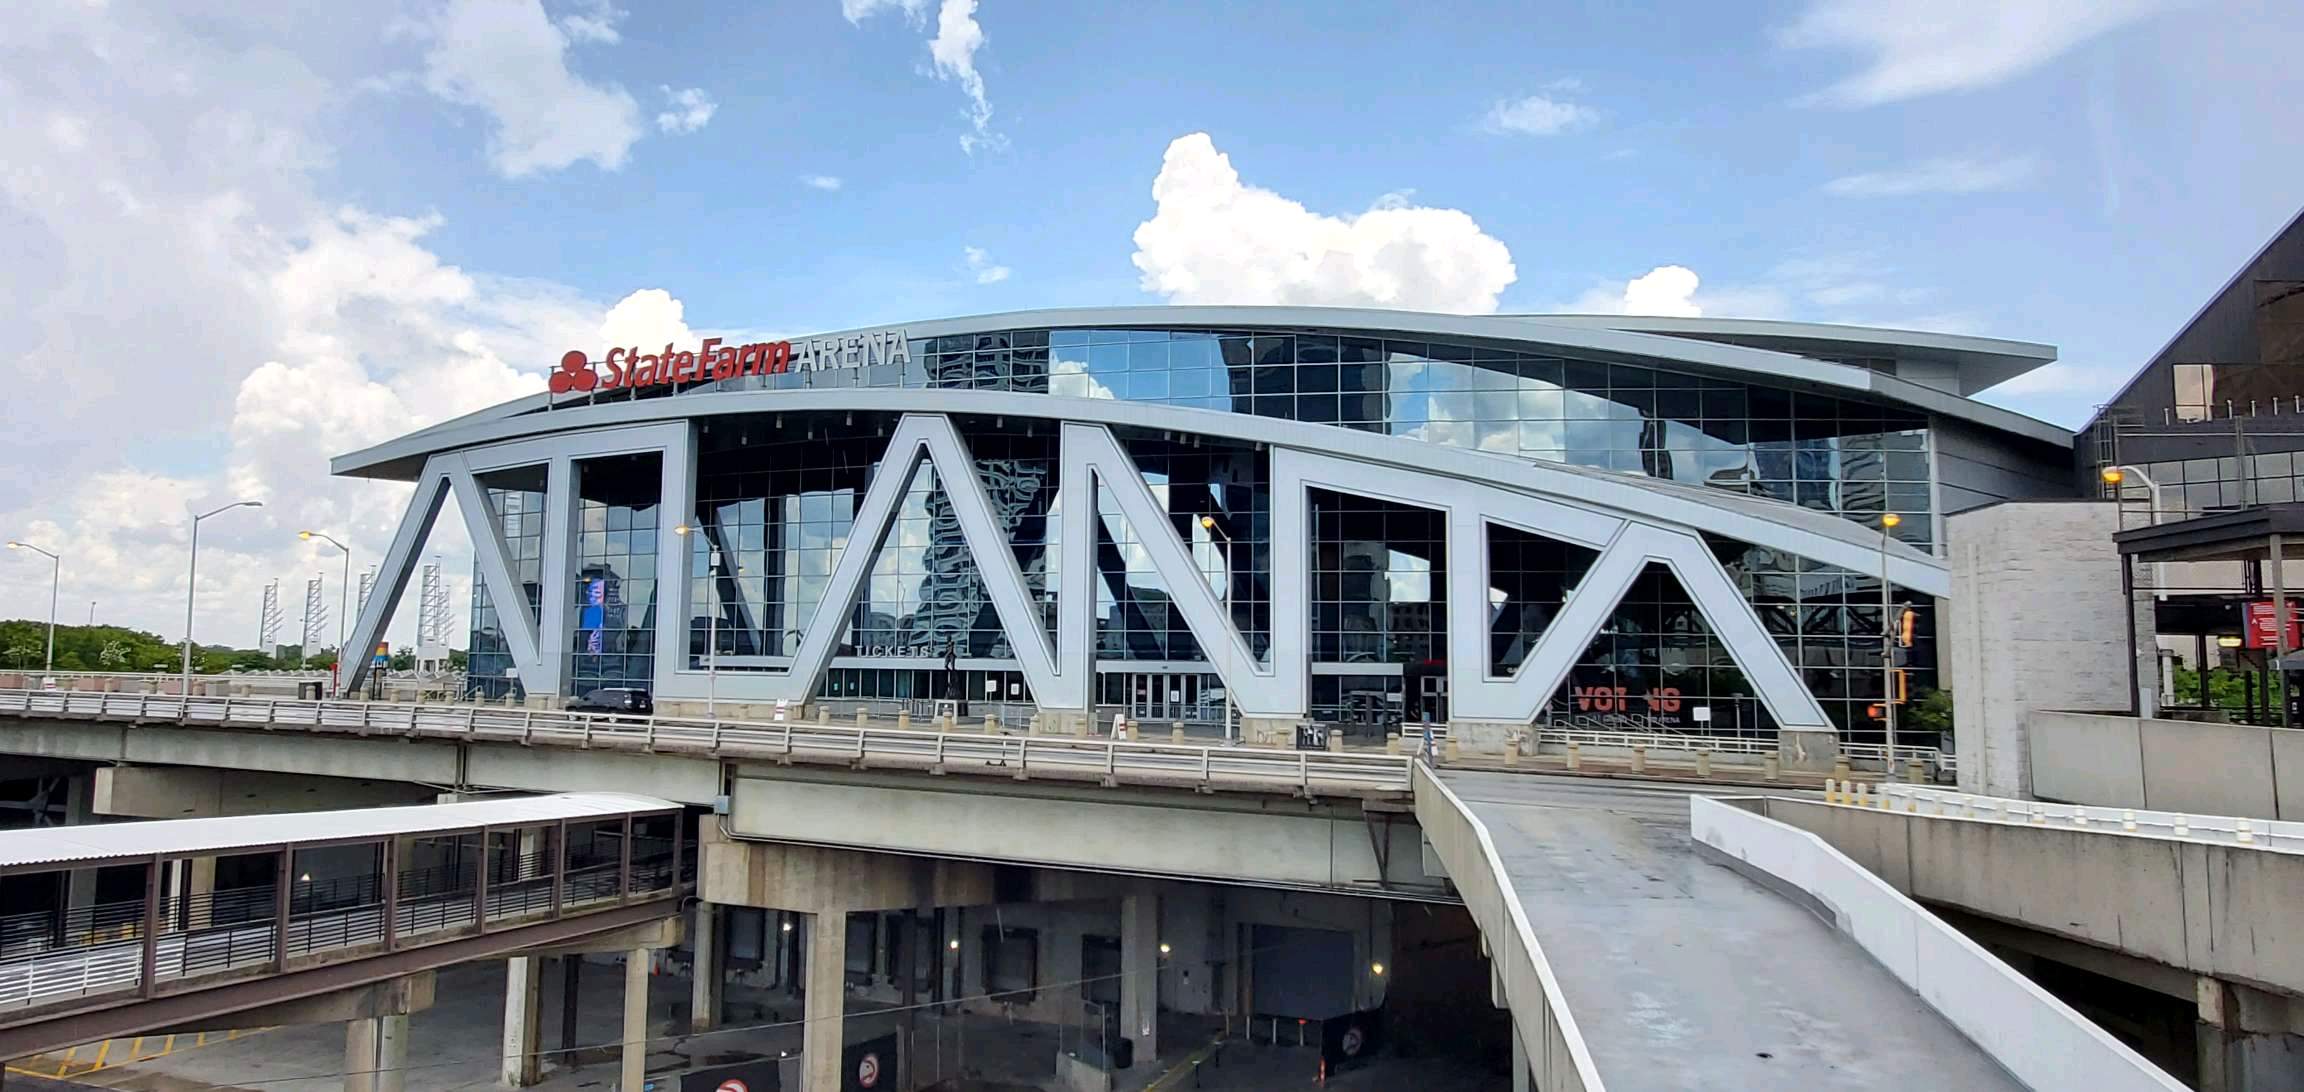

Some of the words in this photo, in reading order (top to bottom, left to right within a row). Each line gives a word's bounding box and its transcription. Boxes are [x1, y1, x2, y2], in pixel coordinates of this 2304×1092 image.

[603, 342, 692, 389] State
[692, 337, 791, 382] Farm
[795, 328, 911, 373] ARENA
[855, 645, 929, 658] TICKETS
[1574, 686, 1680, 712] VOTNG
